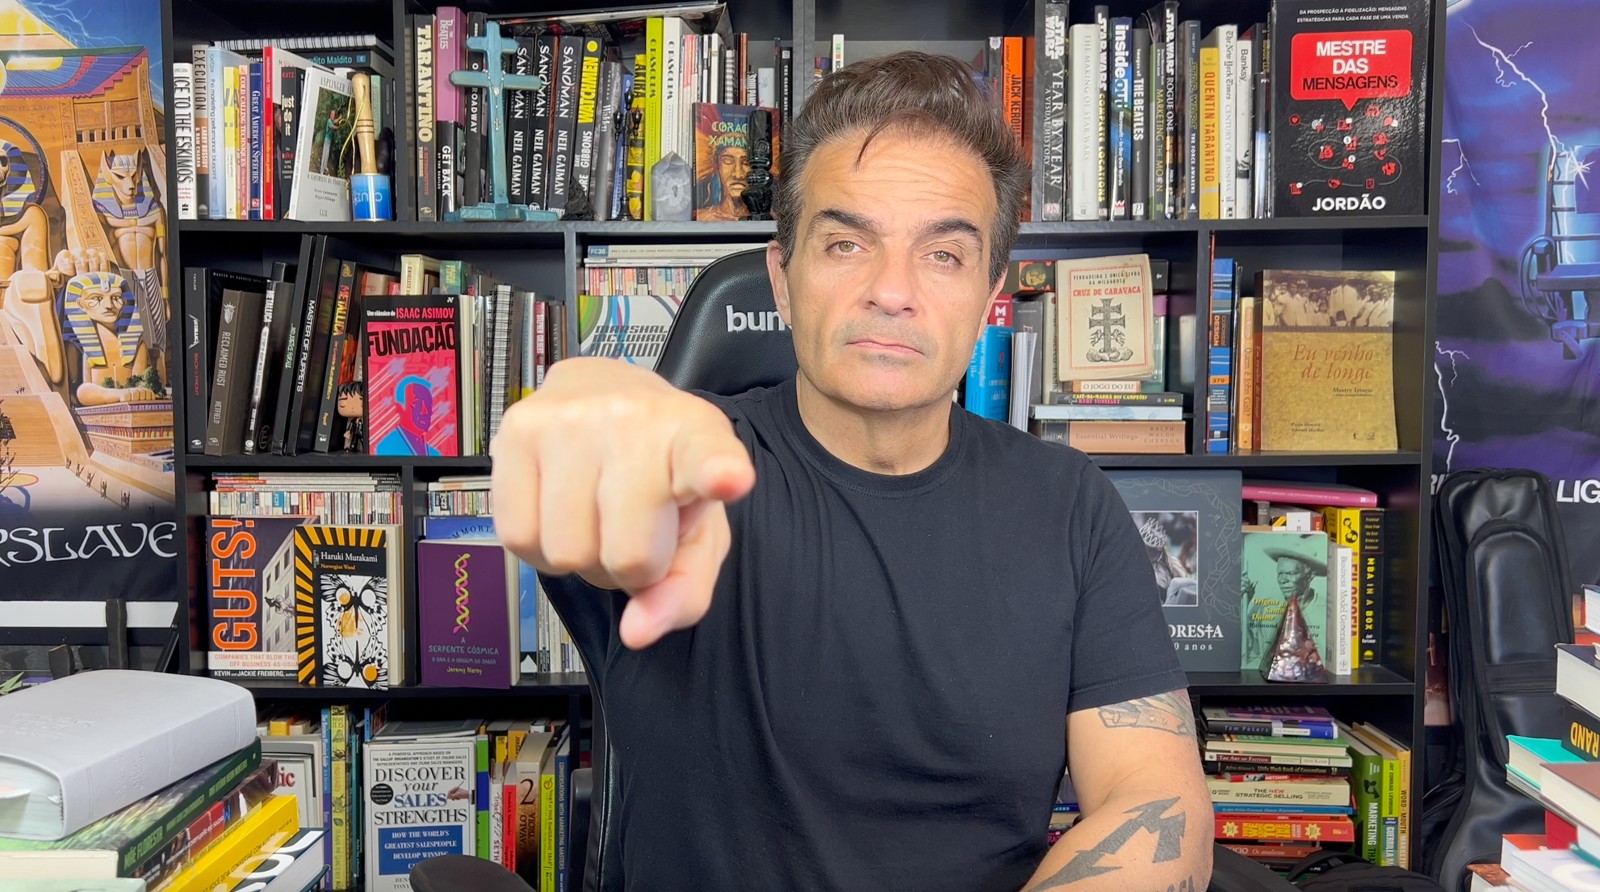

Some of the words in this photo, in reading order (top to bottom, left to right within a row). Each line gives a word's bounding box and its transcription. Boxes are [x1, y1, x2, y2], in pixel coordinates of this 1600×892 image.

[439, 19, 454, 49] BEATLES
[1045, 16, 1055, 60] WARS
[1054, 16, 1065, 60] STAR
[1097, 13, 1107, 49] STAR
[1166, 9, 1174, 42] STAR
[1083, 35, 1091, 53] THE
[1316, 40, 1386, 56] MESTRE
[1099, 50, 1107, 91] WARS
[1166, 42, 1174, 75] WARS
[1239, 49, 1248, 81] Banksy
[1333, 59, 1369, 74] DAS
[173, 76, 190, 93] ICE
[194, 50, 206, 111] EXECUTION
[417, 25, 432, 142] TARANTINO
[535, 45, 551, 117] SANDMAN
[559, 46, 575, 118] SANDMAN
[634, 64, 646, 98] AKIRA
[1011, 74, 1021, 98] JACK
[1083, 55, 1091, 94] MAKING
[1134, 78, 1144, 97] THE
[1303, 75, 1398, 91] MENSAGENS
[175, 96, 191, 109] TO
[252, 90, 261, 113] GREAT
[282, 95, 294, 109] just
[577, 57, 598, 124] WATCHMEN
[1051, 70, 1063, 110] YEAR
[1166, 77, 1174, 108] ROGUE
[1204, 72, 1216, 119] QUENTIN
[175, 112, 191, 133] THE
[284, 110, 292, 124] do
[1083, 111, 1091, 134] STAR
[1133, 99, 1144, 140] BEATLES
[1156, 89, 1164, 141] MARKETING
[252, 115, 260, 149] AMERICAN
[285, 122, 291, 136] it
[513, 130, 523, 152] NEIL
[534, 129, 544, 151] NEIL
[559, 130, 568, 151] NEIL
[1051, 120, 1063, 139] BY
[176, 136, 193, 183] ESKIMOS
[442, 145, 451, 167] GET
[580, 131, 592, 168] GIBBONS
[1083, 136, 1091, 161] WARS
[1204, 124, 1216, 183] TARANTINO
[252, 151, 260, 184] SPEECHES
[512, 155, 522, 196] GAIMAN
[531, 154, 542, 194] GAIMAN
[555, 152, 567, 195] GAIMAN
[1050, 144, 1062, 186] YEAR
[442, 169, 451, 196] BACK
[1312, 193, 1386, 211] JORDÃO
[1105, 286, 1141, 295] CARAVACA
[263, 290, 274, 323] METALLICA
[304, 300, 315, 338] MASTER
[332, 284, 351, 336] METALLICA
[396, 308, 420, 319] ISAAC
[422, 308, 454, 319] ASIMOV
[218, 331, 231, 368] RECLAIMED
[303, 339, 310, 351] OF
[367, 322, 455, 357] FUNDAÇÃO
[1294, 344, 1316, 361] Eu
[1325, 344, 1373, 361] venho
[216, 371, 227, 387] RUST
[296, 353, 308, 392] PUPPETS
[1301, 362, 1321, 379] de
[1327, 363, 1373, 384] longe
[213, 401, 222, 424] HETFIELD
[321, 552, 343, 560] Haruki
[345, 553, 378, 562] Murakami
[1366, 558, 1375, 580] NBA
[211, 519, 257, 650] GUTS!
[1366, 584, 1374, 595] IN
[1340, 590, 1348, 613] Model
[1365, 610, 1374, 631] BOX
[428, 645, 465, 653] SERPENTE
[467, 646, 499, 654] CÓSMICA
[461, 637, 466, 645] A
[1184, 643, 1213, 651] anos
[1570, 721, 1600, 758] RAND
[375, 766, 466, 782] DISCOVER
[394, 793, 447, 808] SALES
[404, 782, 439, 795] your
[520, 778, 535, 806] 2
[374, 809, 467, 825] STRENGTHS
[1367, 802, 1378, 845] MARKETING
